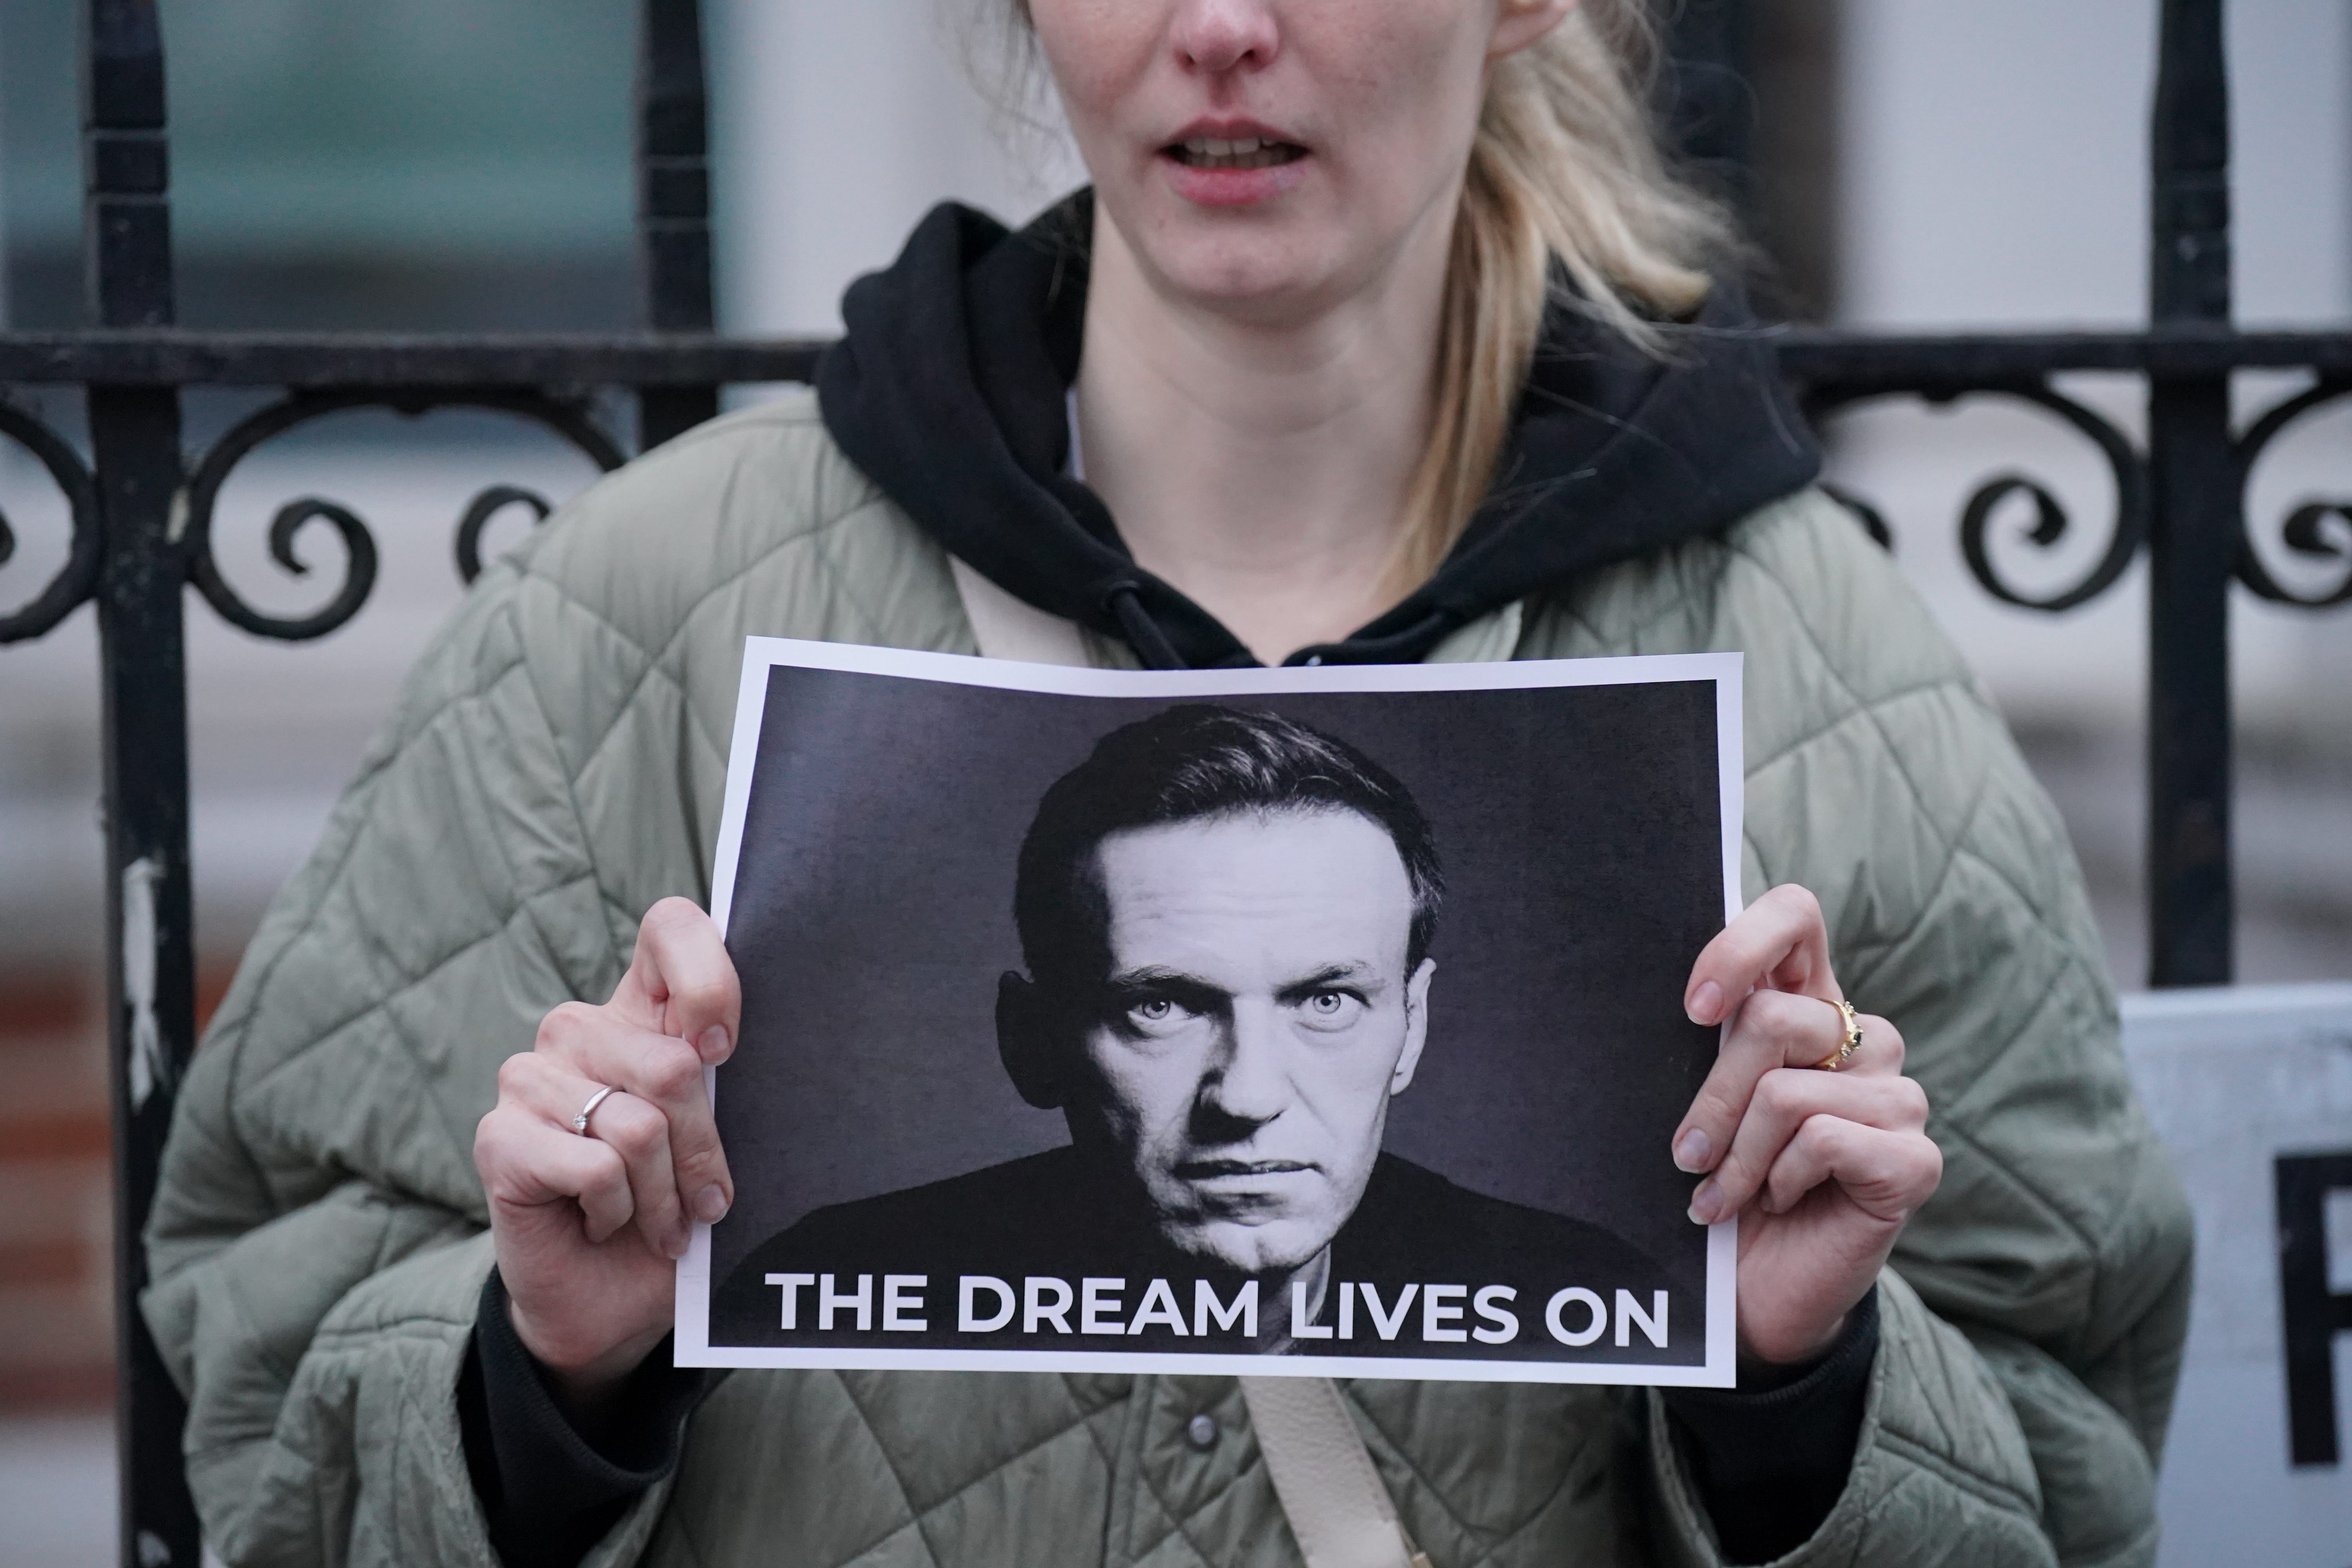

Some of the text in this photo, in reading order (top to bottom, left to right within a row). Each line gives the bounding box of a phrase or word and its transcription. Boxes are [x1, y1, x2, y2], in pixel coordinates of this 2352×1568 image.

[764, 1273, 1668, 1348] THE DREAM LIVES ON
